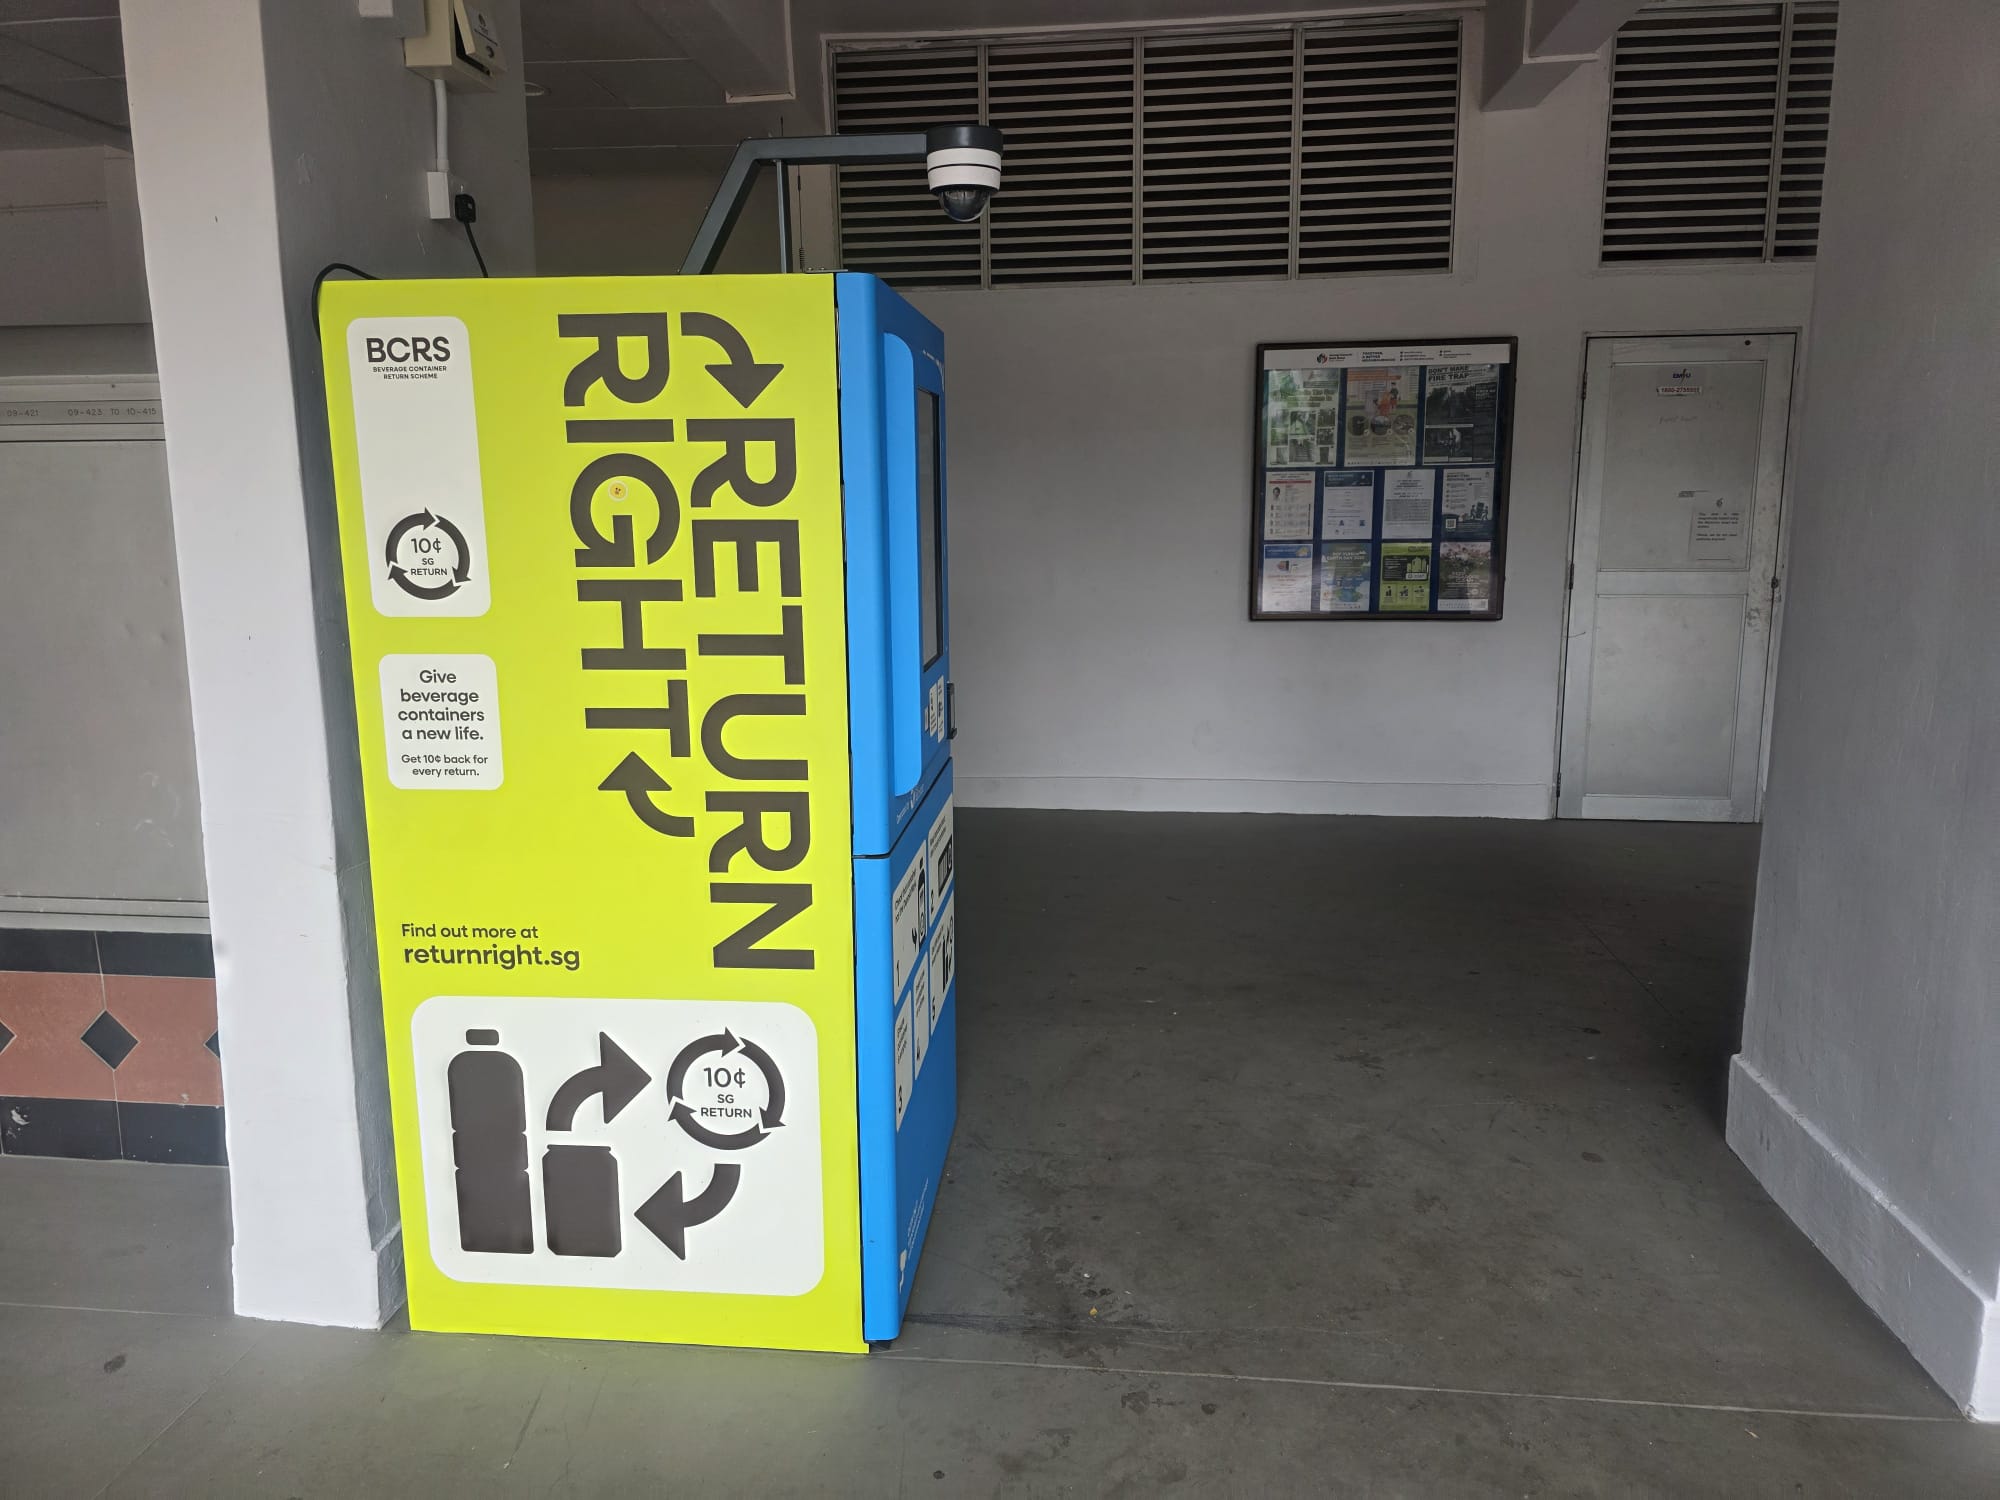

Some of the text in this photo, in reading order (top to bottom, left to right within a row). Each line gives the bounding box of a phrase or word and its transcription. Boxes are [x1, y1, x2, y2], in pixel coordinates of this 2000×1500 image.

[366, 336, 451, 363] BCRS
[410, 372, 438, 380] SCHEME
[67, 408, 103, 416] 09-423
[126, 407, 157, 416] 10-415
[558, 312, 692, 758] RIGHT
[411, 538, 441, 553] 10¢
[421, 557, 435, 566] SG
[410, 567, 448, 576] RETURN
[420, 669, 456, 683] Give
[400, 687, 479, 706] beverage
[686, 417, 816, 970] RETURN
[398, 707, 484, 721] containers
[401, 726, 483, 740] a new life.
[401, 754, 489, 765] Get 10¢ back for
[412, 767, 480, 778] every return.
[402, 923, 539, 939] Find out more at
[405, 944, 579, 971] returnright.sg
[704, 1068, 745, 1088] 10¢
[717, 1093, 735, 1104] SG
[700, 1106, 753, 1119] RETURN
